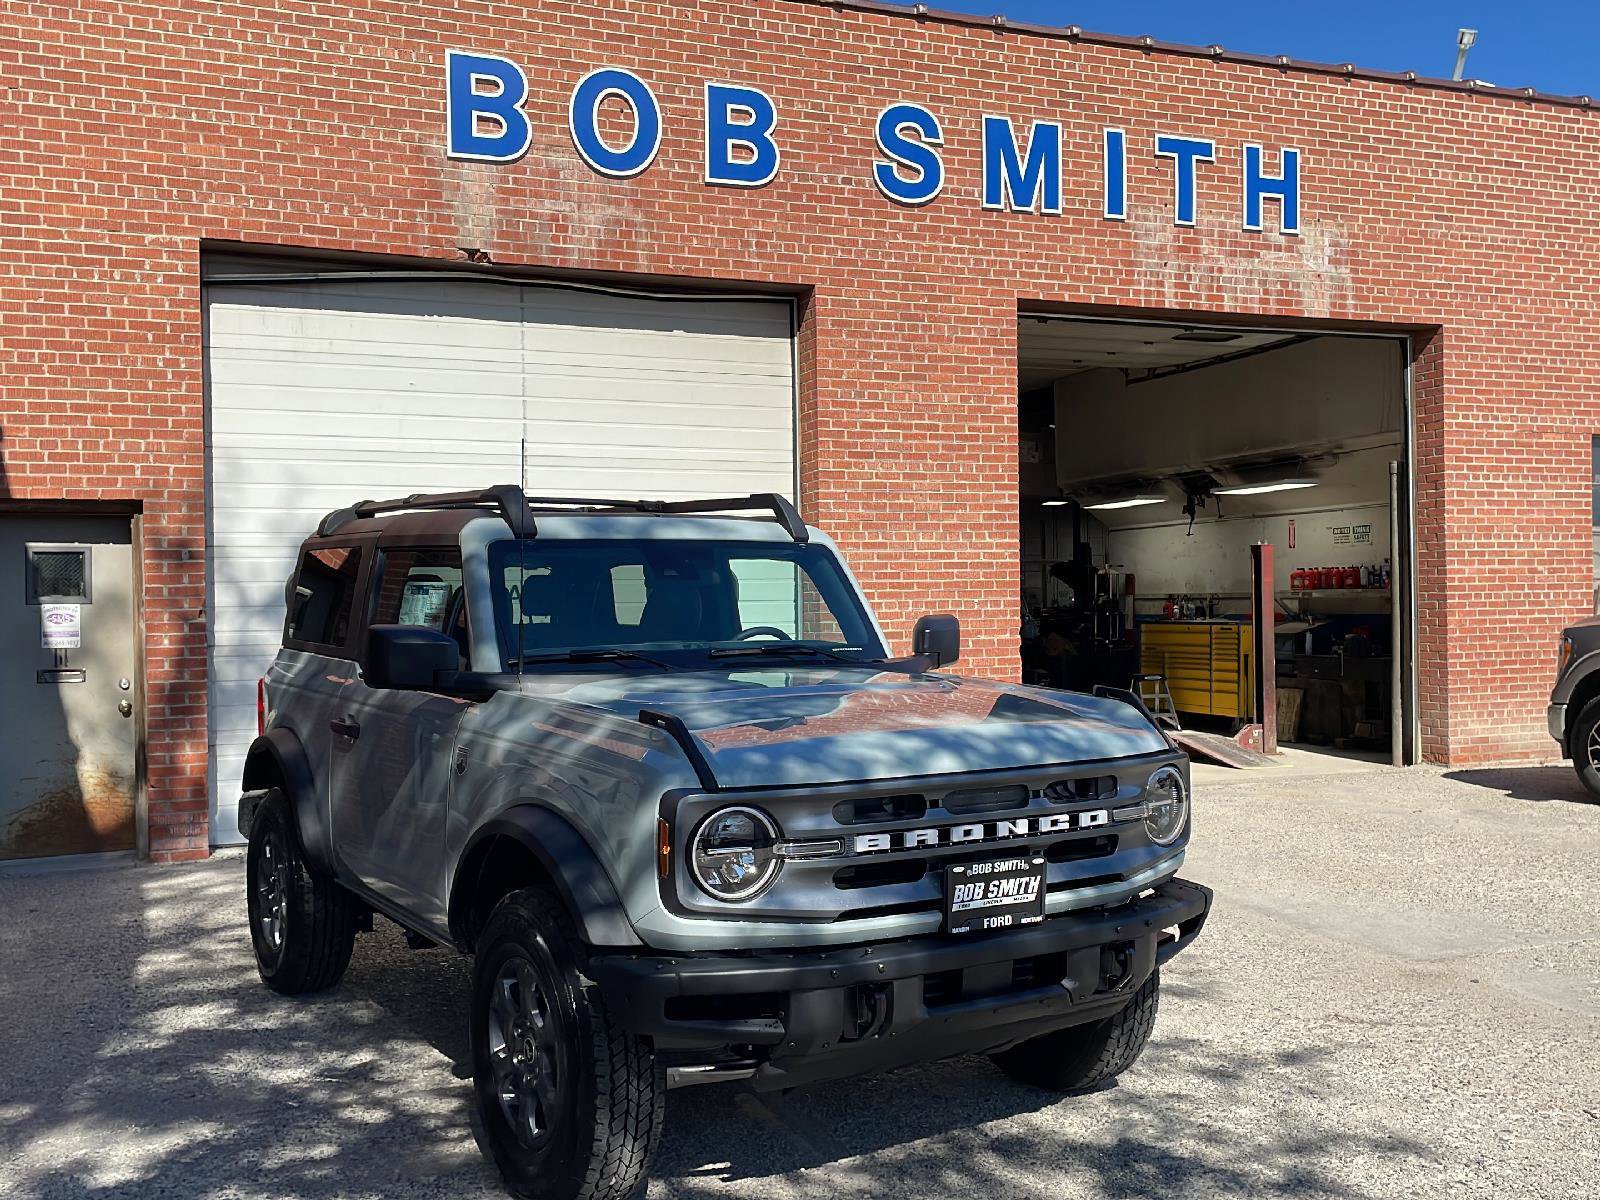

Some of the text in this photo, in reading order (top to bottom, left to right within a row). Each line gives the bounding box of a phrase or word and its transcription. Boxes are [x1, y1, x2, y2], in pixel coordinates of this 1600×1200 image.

[445, 49, 1300, 234] BOB SMITH
[854, 810, 1108, 852] BRONCO
[972, 863, 992, 875] BOB
[994, 860, 1025, 873] SMITH
[953, 875, 1042, 903] BOB SMITH
[984, 915, 1013, 928] FORD
